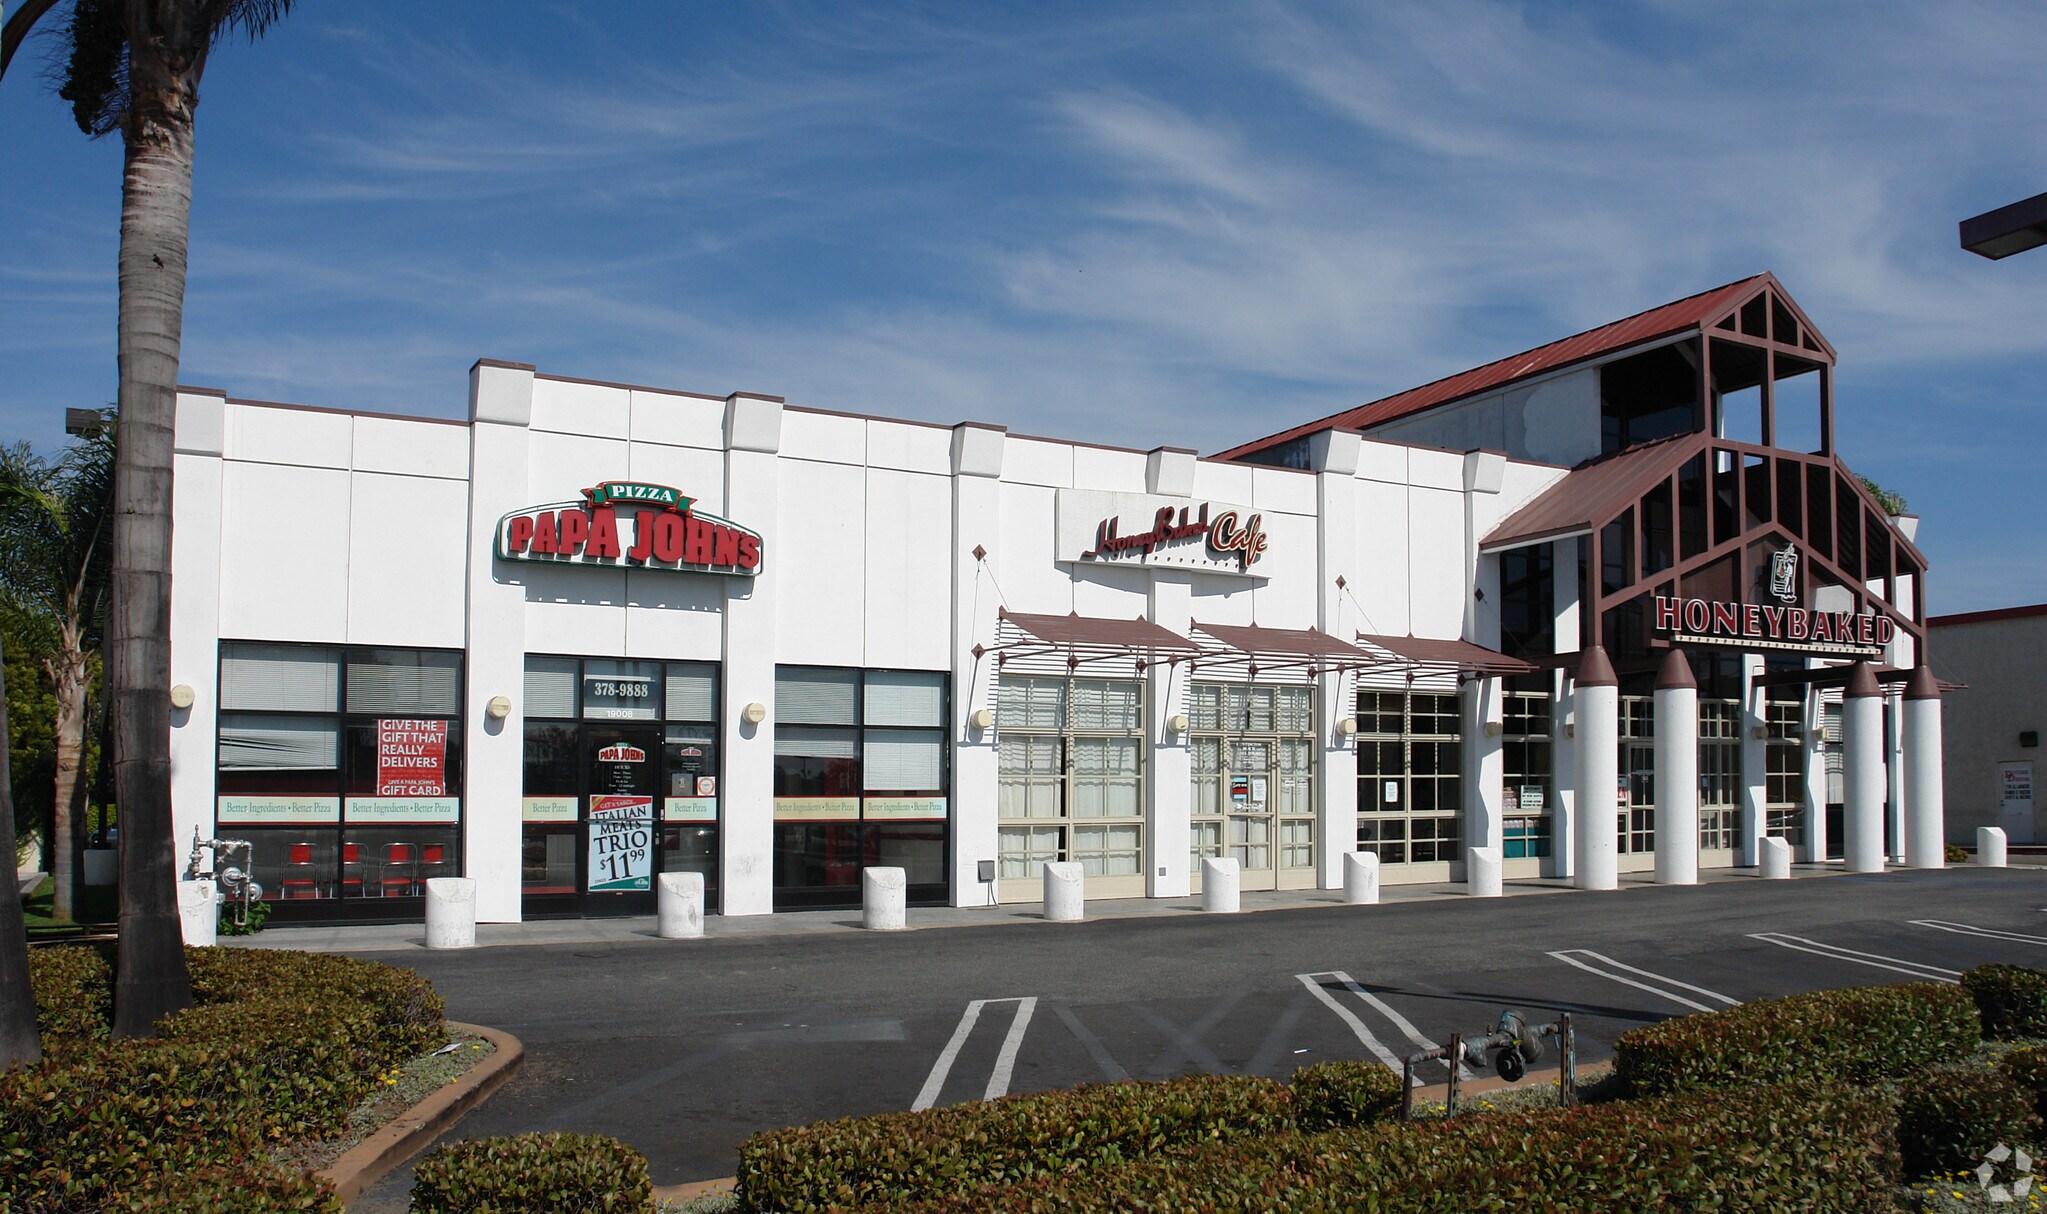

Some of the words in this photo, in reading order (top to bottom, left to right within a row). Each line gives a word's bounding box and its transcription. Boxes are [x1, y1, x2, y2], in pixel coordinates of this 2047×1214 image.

[611, 484, 673, 502] PIZZA
[510, 508, 620, 558] PAPA
[1655, 595, 1896, 646] HONEYBAKED
[594, 682, 648, 698] 378-9888
[607, 709, 633, 718] 19008
[382, 719, 412, 731] GIVE
[413, 720, 437, 731] THE
[382, 731, 409, 742] GIFT
[411, 732, 444, 743] THAT
[381, 744, 425, 755] REALLY
[600, 748, 619, 760] PAPA
[381, 756, 437, 768] DELIVERS
[381, 785, 407, 796] GIFT
[408, 786, 441, 796] CARD
[226, 802, 247, 813] Better
[249, 802, 287, 815] Ingredients
[292, 802, 312, 813] Better
[314, 802, 331, 812] Pizza
[352, 803, 372, 813] Better
[374, 803, 409, 815] Ingredients
[414, 803, 433, 813] Better
[434, 803, 451, 812] Pizza
[532, 802, 551, 812] Better
[552, 802, 568, 812] Pizza
[675, 803, 691, 812] Better
[693, 803, 707, 812] Pizza
[595, 806, 647, 823] ITALIAN
[600, 820, 642, 835] MEATS
[594, 831, 648, 854] TRIO
